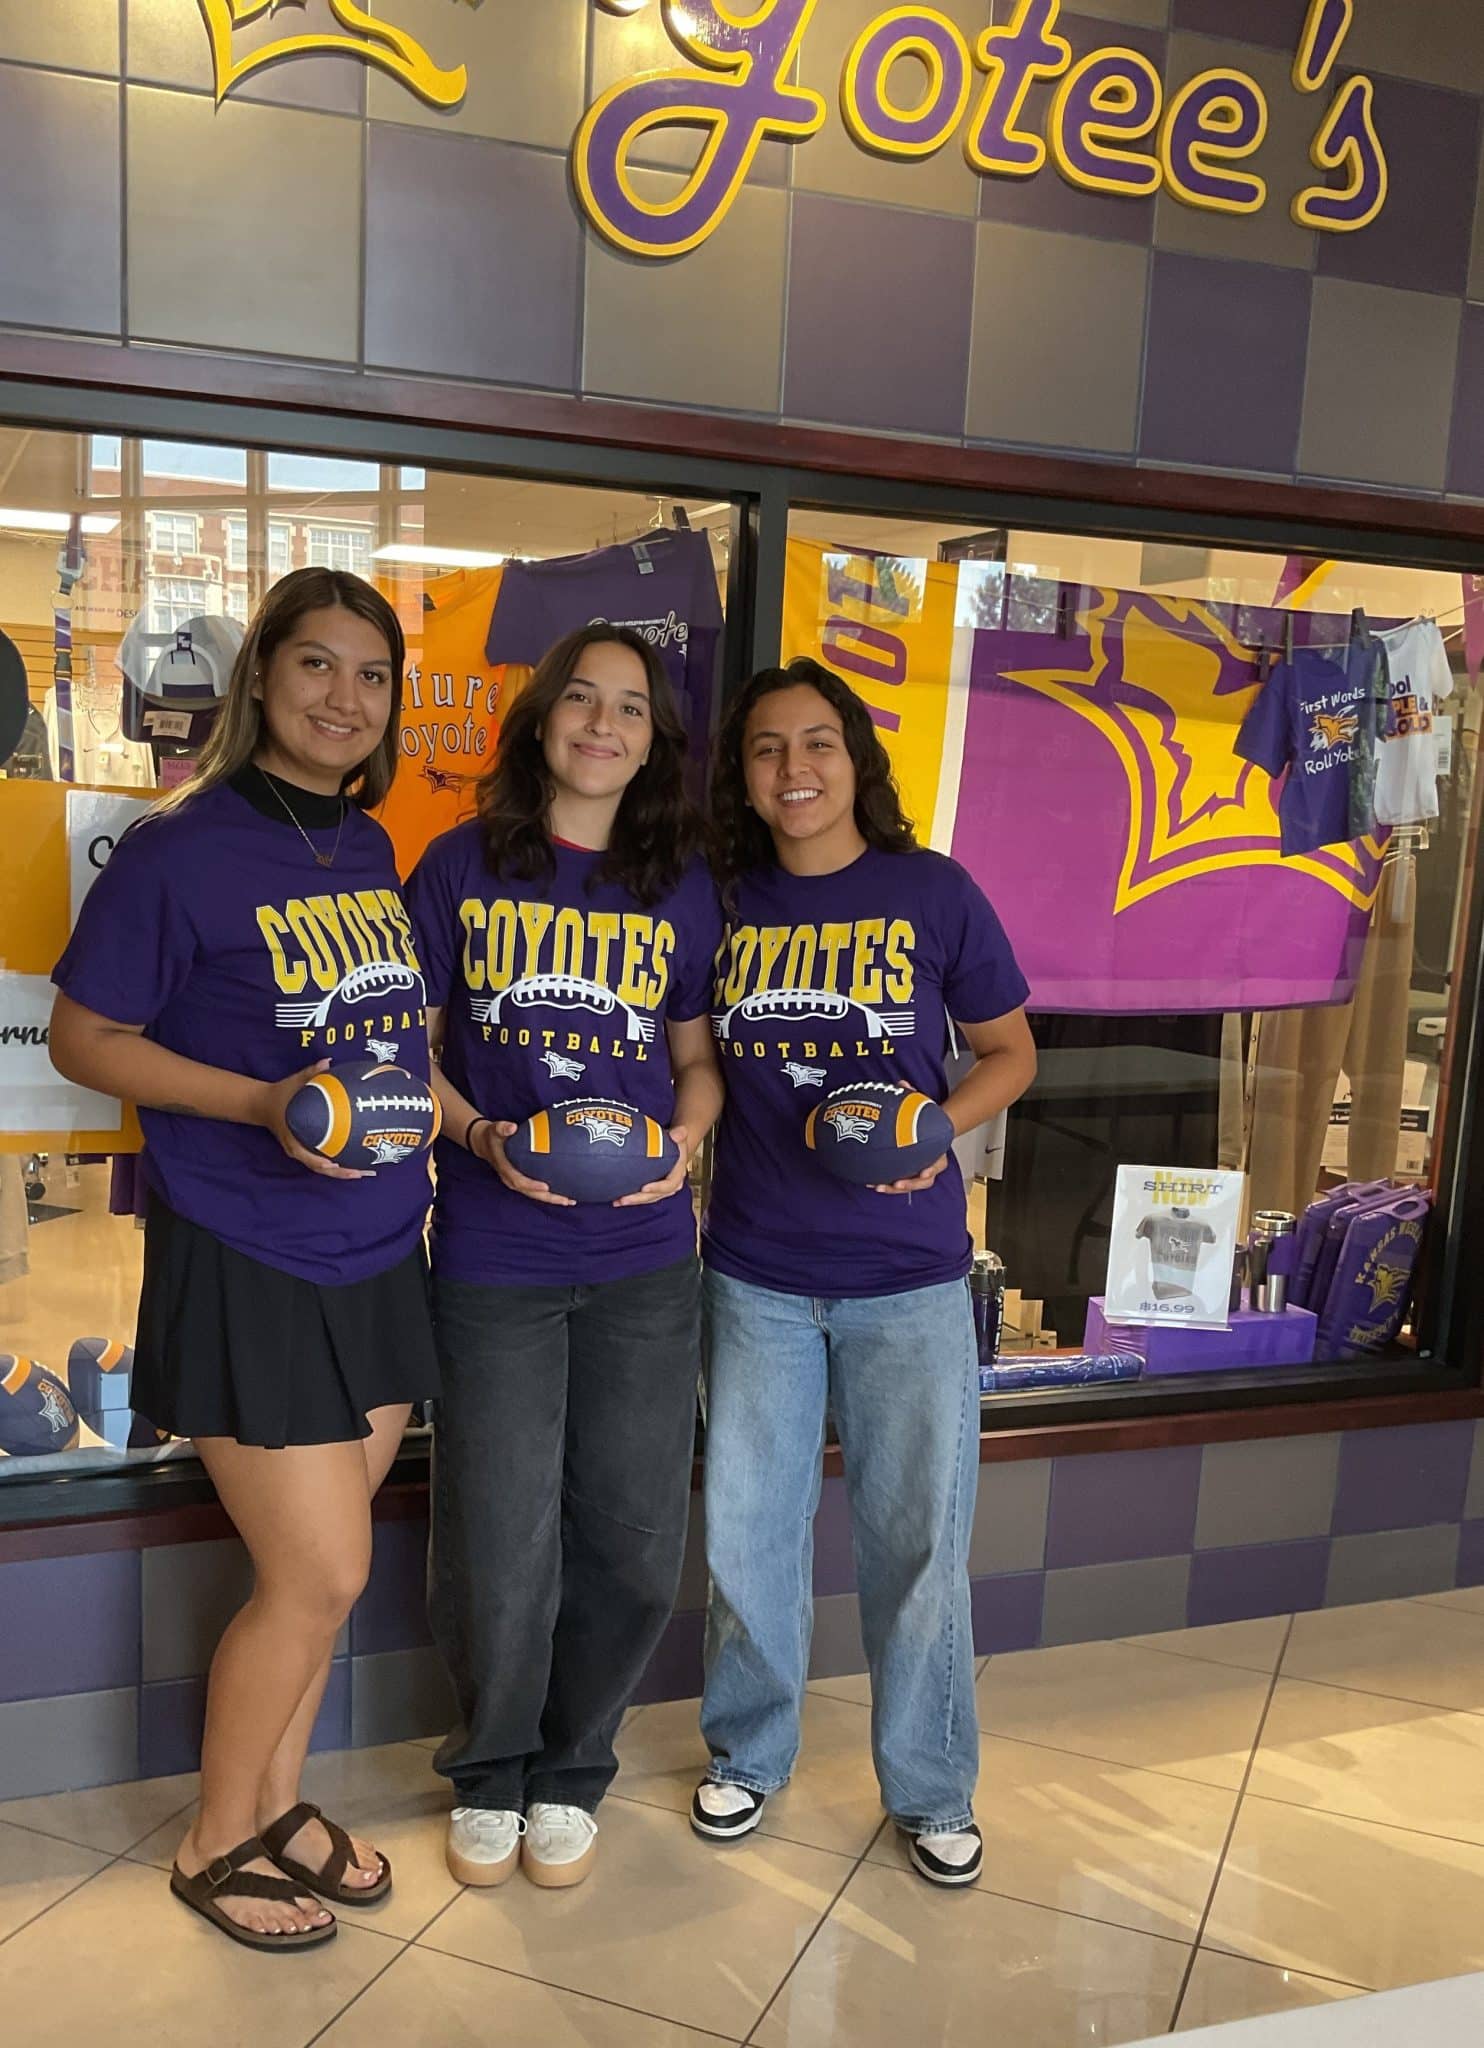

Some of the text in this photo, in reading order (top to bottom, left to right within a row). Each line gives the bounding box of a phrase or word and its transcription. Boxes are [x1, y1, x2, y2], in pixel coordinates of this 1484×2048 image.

[399, 663, 499, 713] ture
[1331, 687, 1366, 707] Words
[397, 713, 487, 763] oyote
[1304, 753, 1333, 775] Roll
[87, 835, 116, 869] C
[256, 889, 421, 994] COYOTE
[459, 898, 676, 1011] COYOTES
[300, 1008, 427, 1048] FOOTBAL
[481, 1024, 648, 1061] FOOTBALL
[565, 1110, 633, 1128] COYOTES
[361, 1132, 422, 1148] COYOTES
[1143, 1179, 1225, 1197] SHIRT
